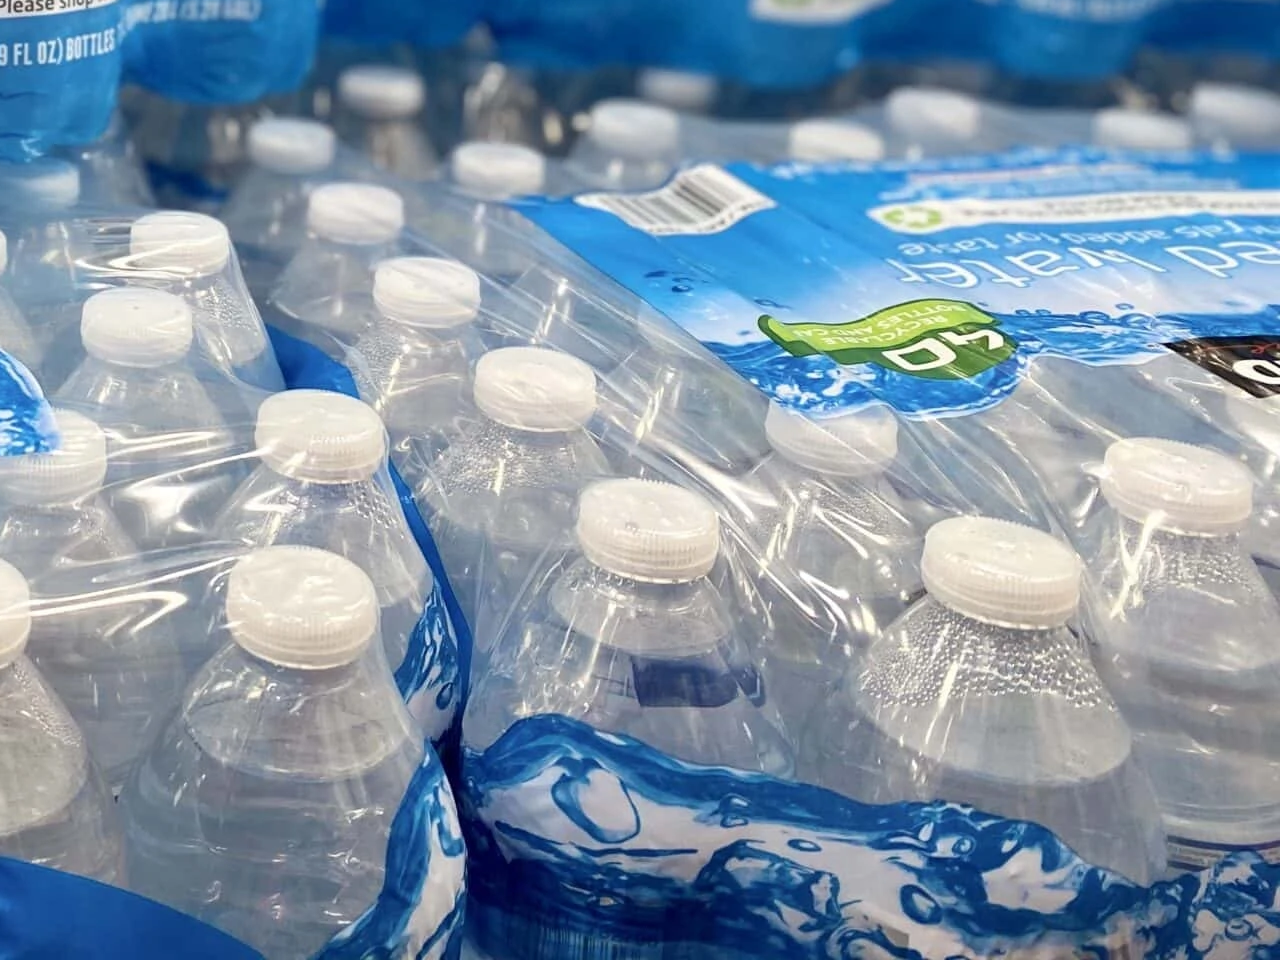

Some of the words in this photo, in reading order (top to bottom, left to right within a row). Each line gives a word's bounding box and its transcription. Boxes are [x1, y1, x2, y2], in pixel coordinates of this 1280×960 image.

[14, 43, 32, 66] FL
[37, 37, 64, 65] OZ)
[65, 27, 115, 62] BOTTLES
[898, 237, 1000, 256] taste
[885, 246, 1167, 288] water
[881, 329, 1004, 371] 40
